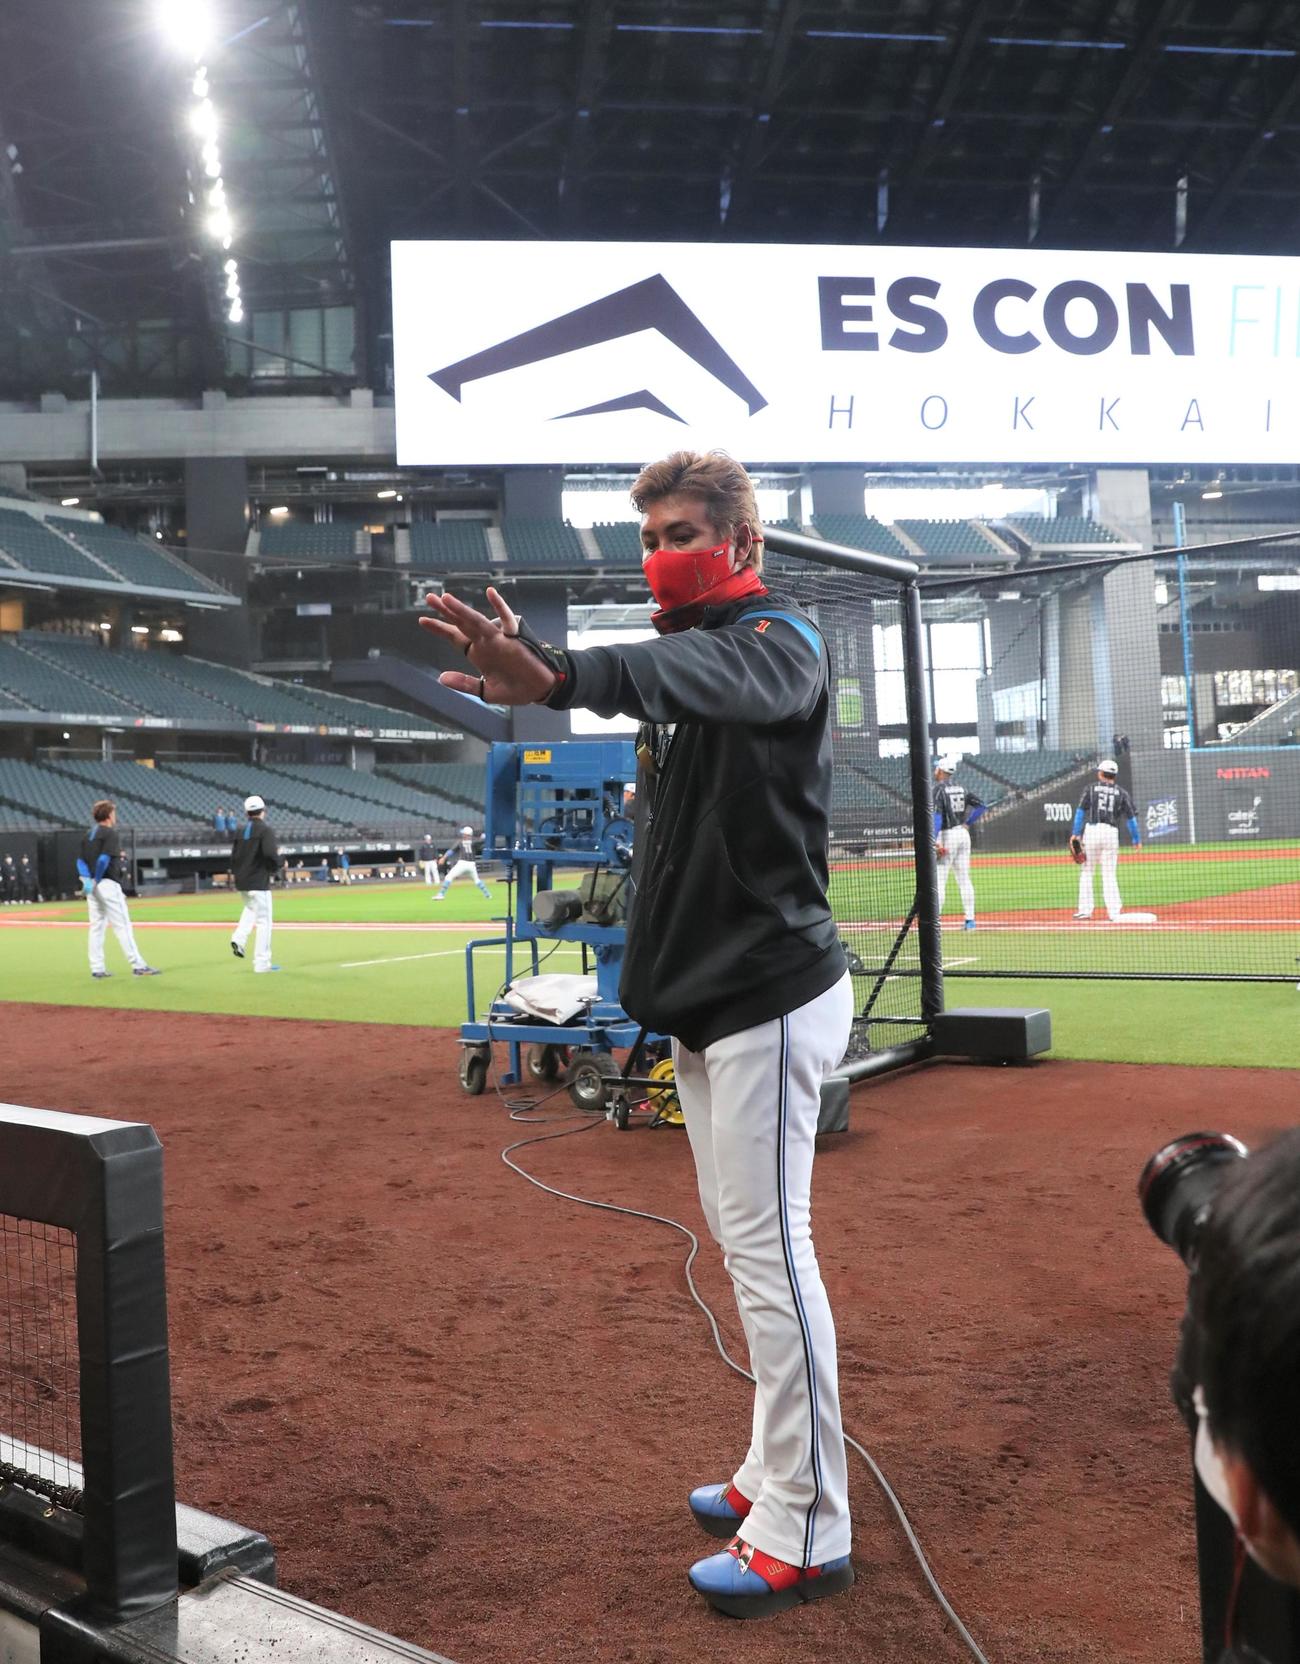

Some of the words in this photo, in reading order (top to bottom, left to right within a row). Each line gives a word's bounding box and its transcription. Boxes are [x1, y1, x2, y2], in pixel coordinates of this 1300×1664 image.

[817, 276, 948, 353] ES
[973, 278, 1194, 356] CON
[1227, 284, 1300, 358] FI
[754, 619, 771, 633] 1
[1097, 793, 1115, 812] 21
[1145, 799, 1178, 821] ASK
[1043, 803, 1073, 821] TOTO
[1145, 814, 1179, 830] GATE
